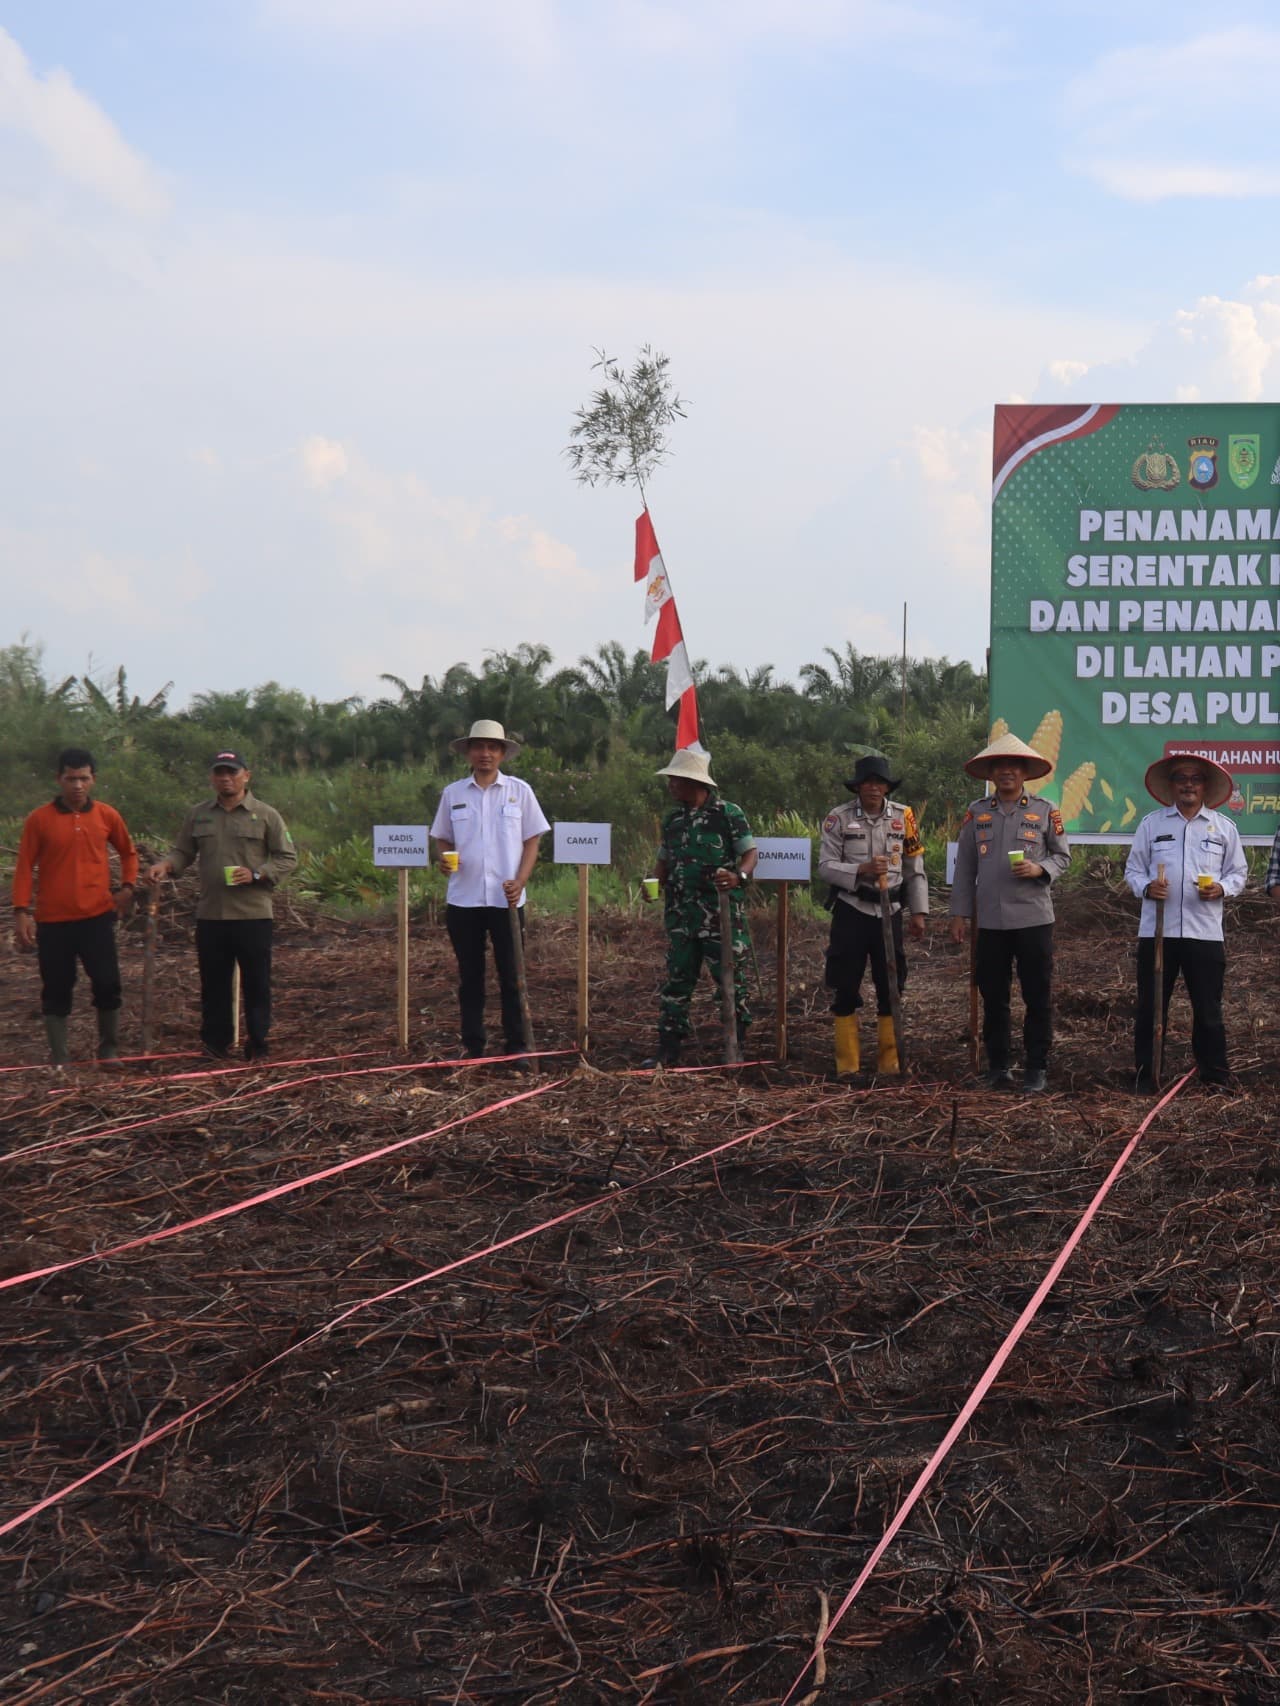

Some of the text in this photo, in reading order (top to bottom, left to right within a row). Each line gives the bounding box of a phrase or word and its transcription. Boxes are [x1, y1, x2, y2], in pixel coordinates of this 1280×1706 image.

[1190, 438, 1215, 446] RIAU
[1066, 553, 1267, 587] SERENTAK
[1030, 600, 1109, 632] DAN
[1076, 645, 1115, 678] DI
[1124, 644, 1251, 677] LAHAN
[1102, 691, 1199, 724] DESA
[1169, 750, 1262, 765] ILAHAN
[388, 834, 414, 843] KADIS
[566, 836, 599, 846] CAMAT
[377, 846, 425, 855] PERTANIAN
[758, 851, 806, 861] DANRAMIL
